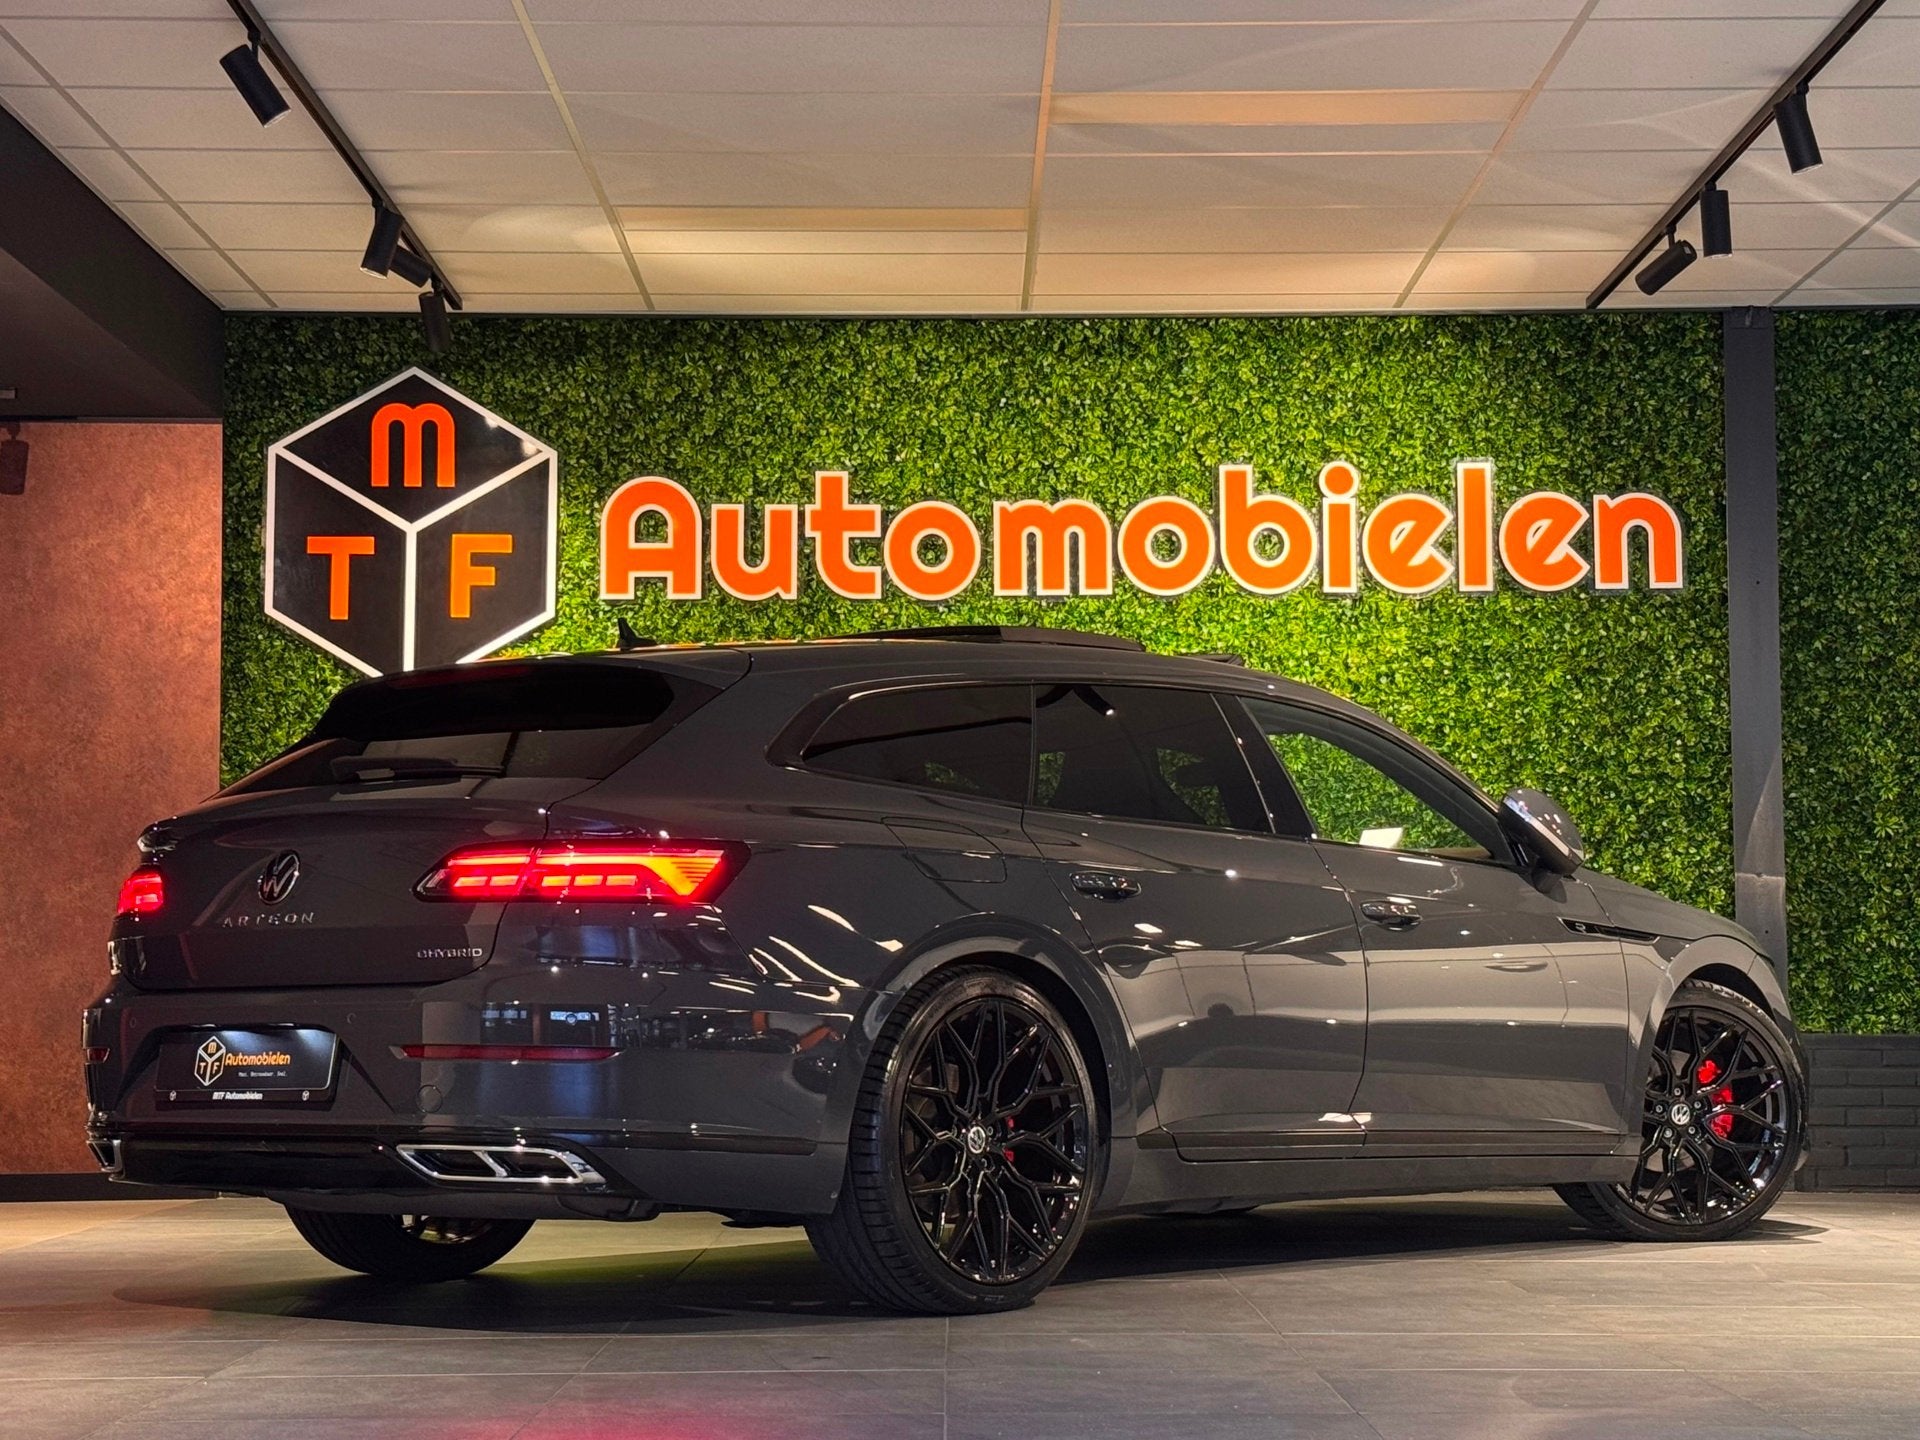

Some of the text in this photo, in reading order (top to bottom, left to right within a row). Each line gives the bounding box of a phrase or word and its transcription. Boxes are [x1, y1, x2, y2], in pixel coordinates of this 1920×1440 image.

[600, 459, 1684, 601] Automobielen
[306, 533, 514, 621] T F
[225, 1052, 291, 1066] Automobielen
